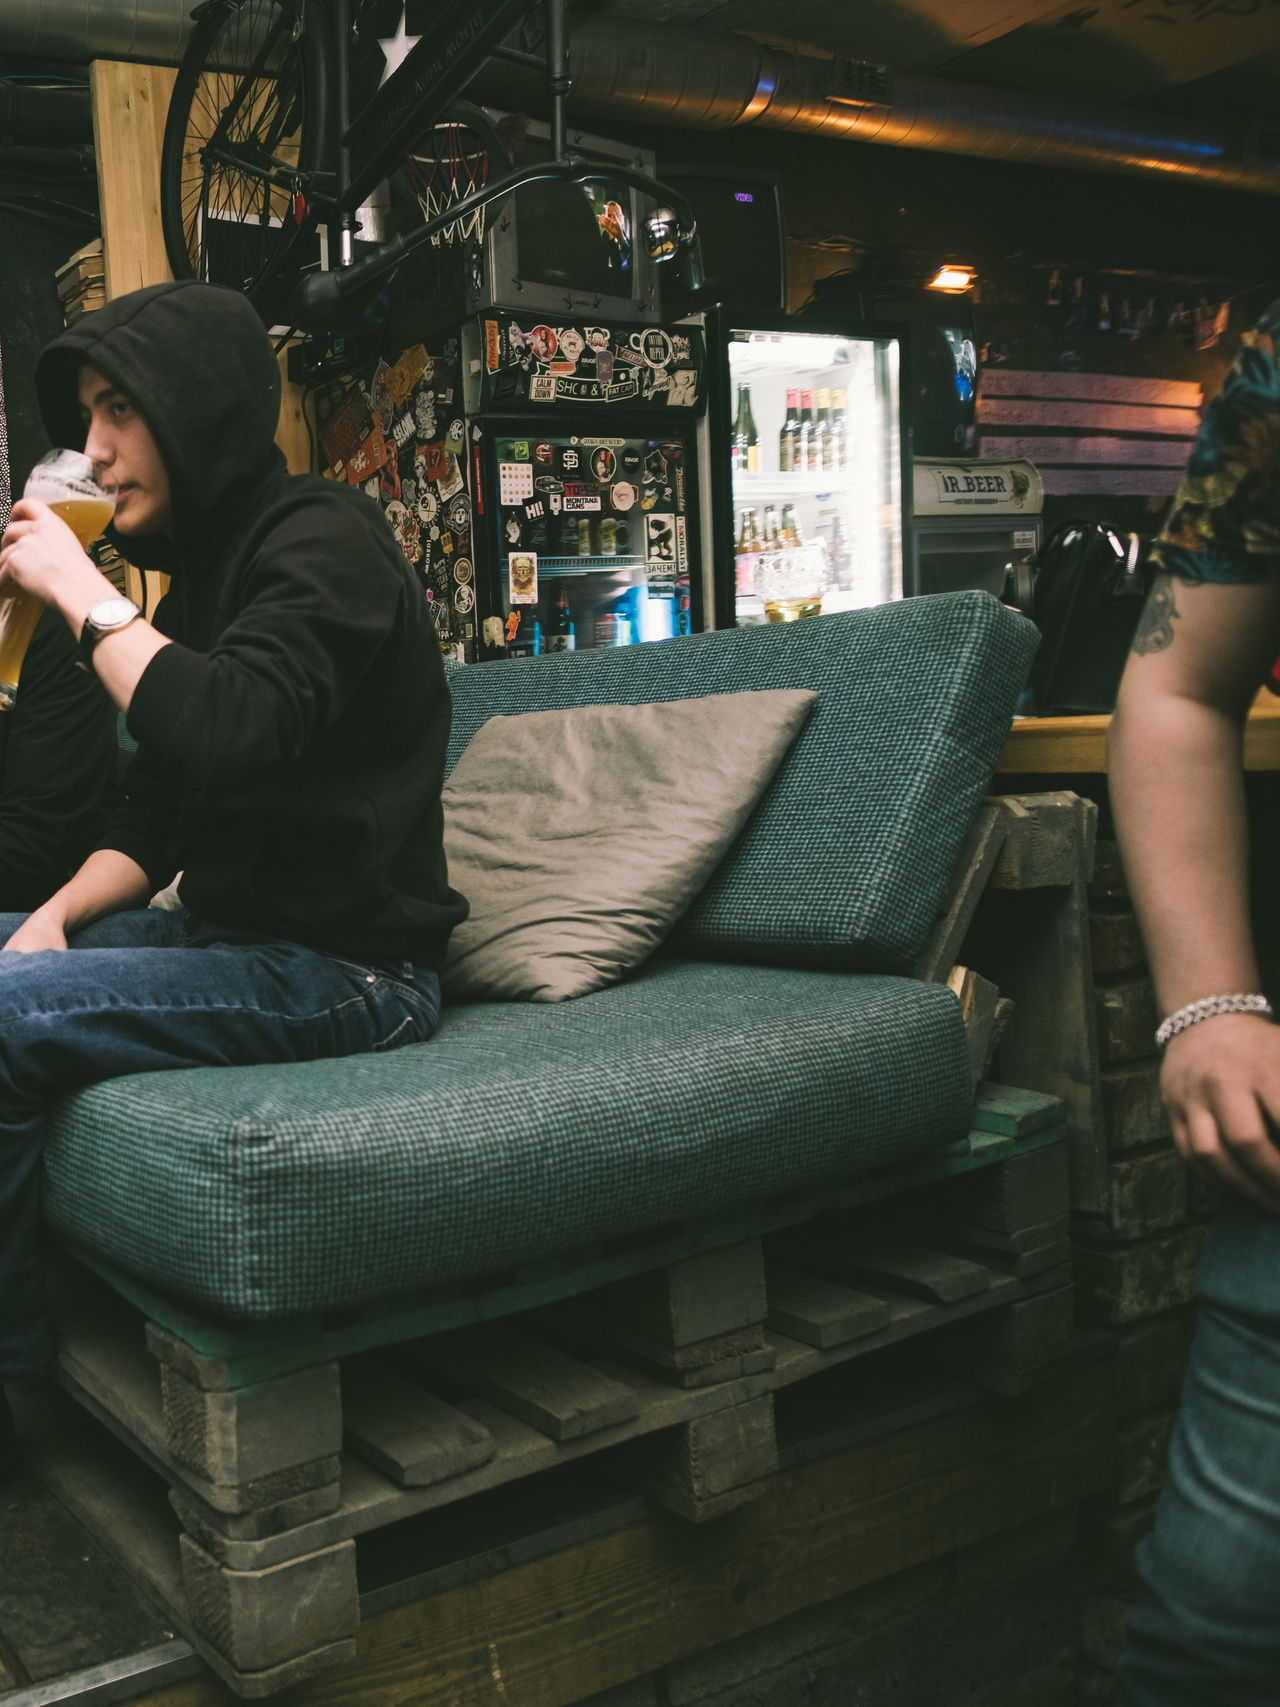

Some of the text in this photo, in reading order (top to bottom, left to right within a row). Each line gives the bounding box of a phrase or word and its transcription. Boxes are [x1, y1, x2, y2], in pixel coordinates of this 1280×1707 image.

[735, 192, 753, 202] VIDEO
[536, 379, 552, 388] CALM
[534, 389, 551, 399] DOWN
[608, 387, 620, 396] FAT
[620, 383, 633, 394] CAP
[525, 501, 545, 519] HI!
[647, 564, 676, 573] ЗАЧЕМ!
